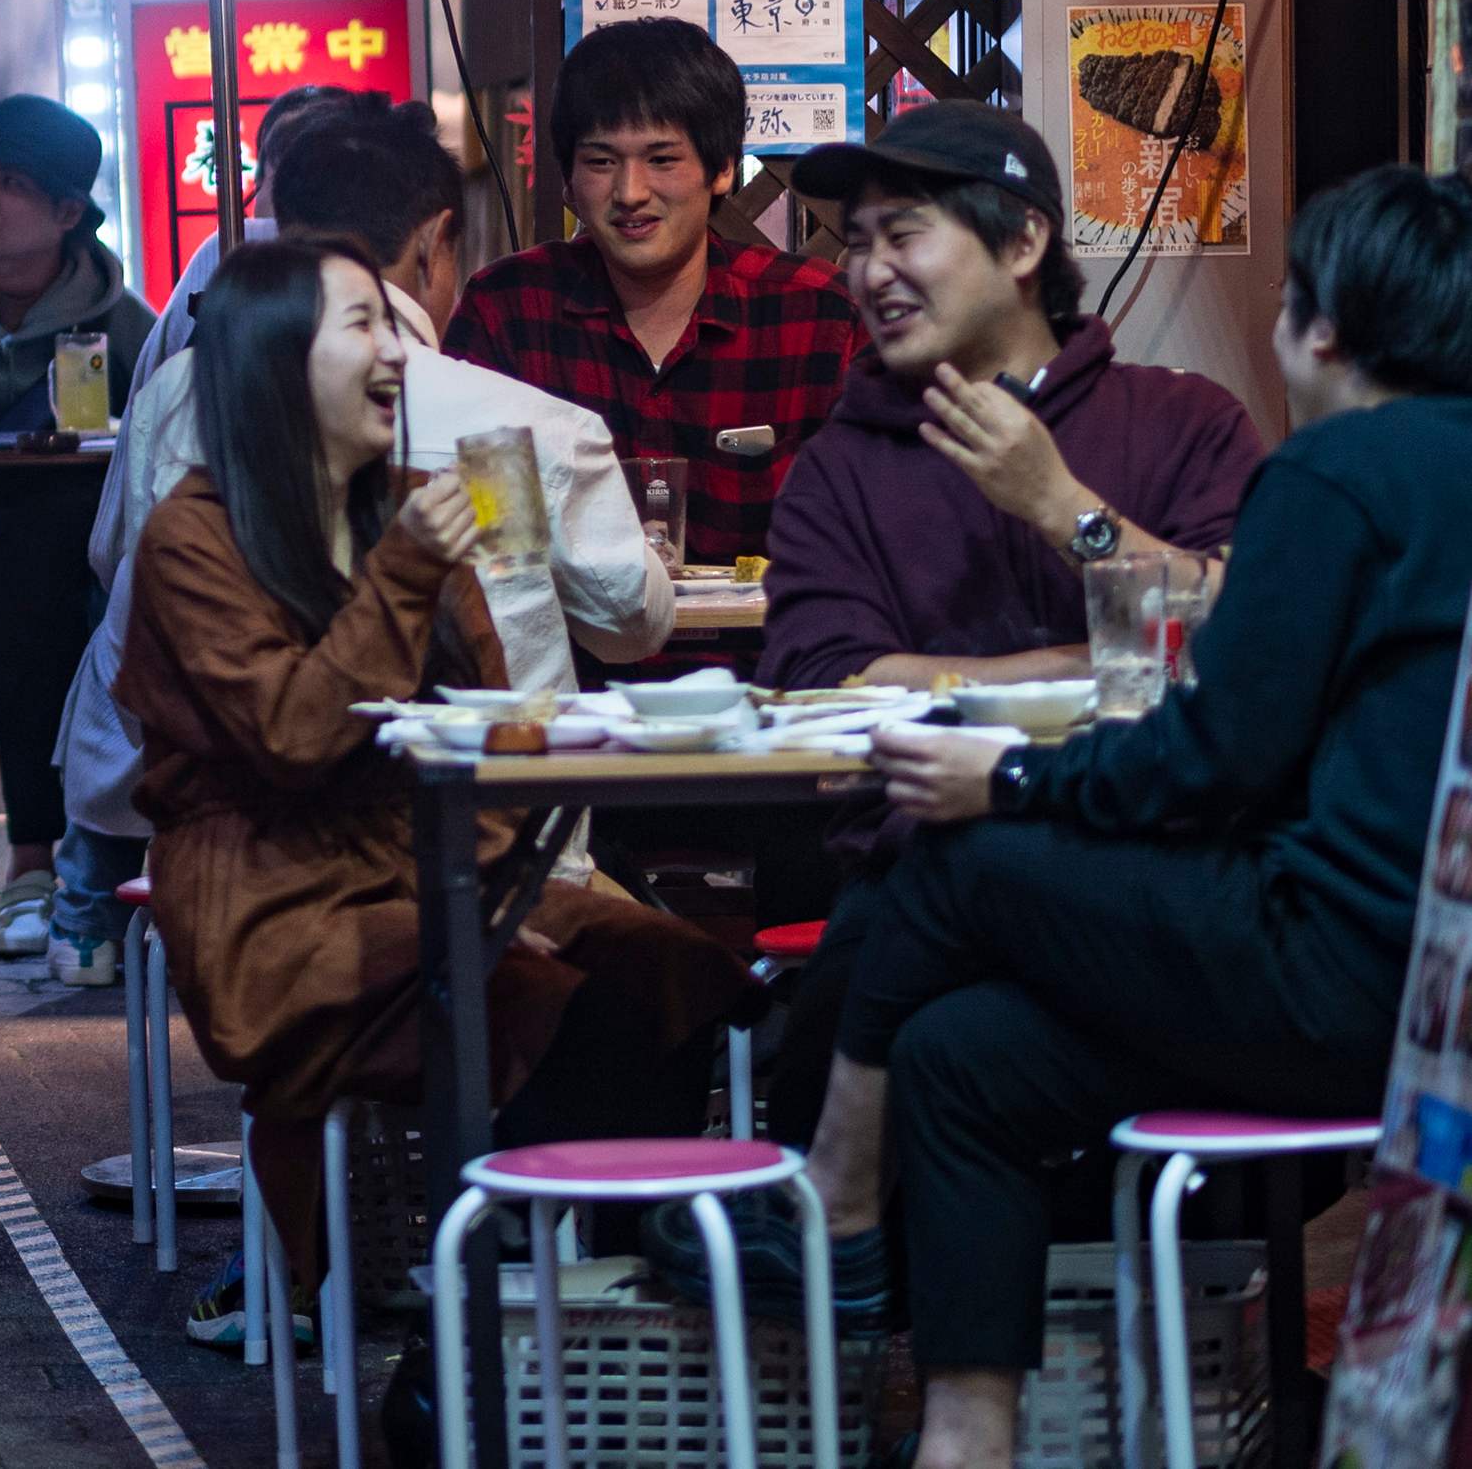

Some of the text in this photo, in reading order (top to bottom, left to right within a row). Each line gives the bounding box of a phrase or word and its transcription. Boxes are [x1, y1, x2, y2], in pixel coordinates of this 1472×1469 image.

[164, 18, 386, 79] 営業中
[1074, 129, 1089, 171] ライス
[1091, 113, 1108, 156] カレー
[1184, 134, 1200, 189] おいしい
[1121, 161, 1138, 227] の歩き方
[1138, 135, 1180, 227] 新宿
